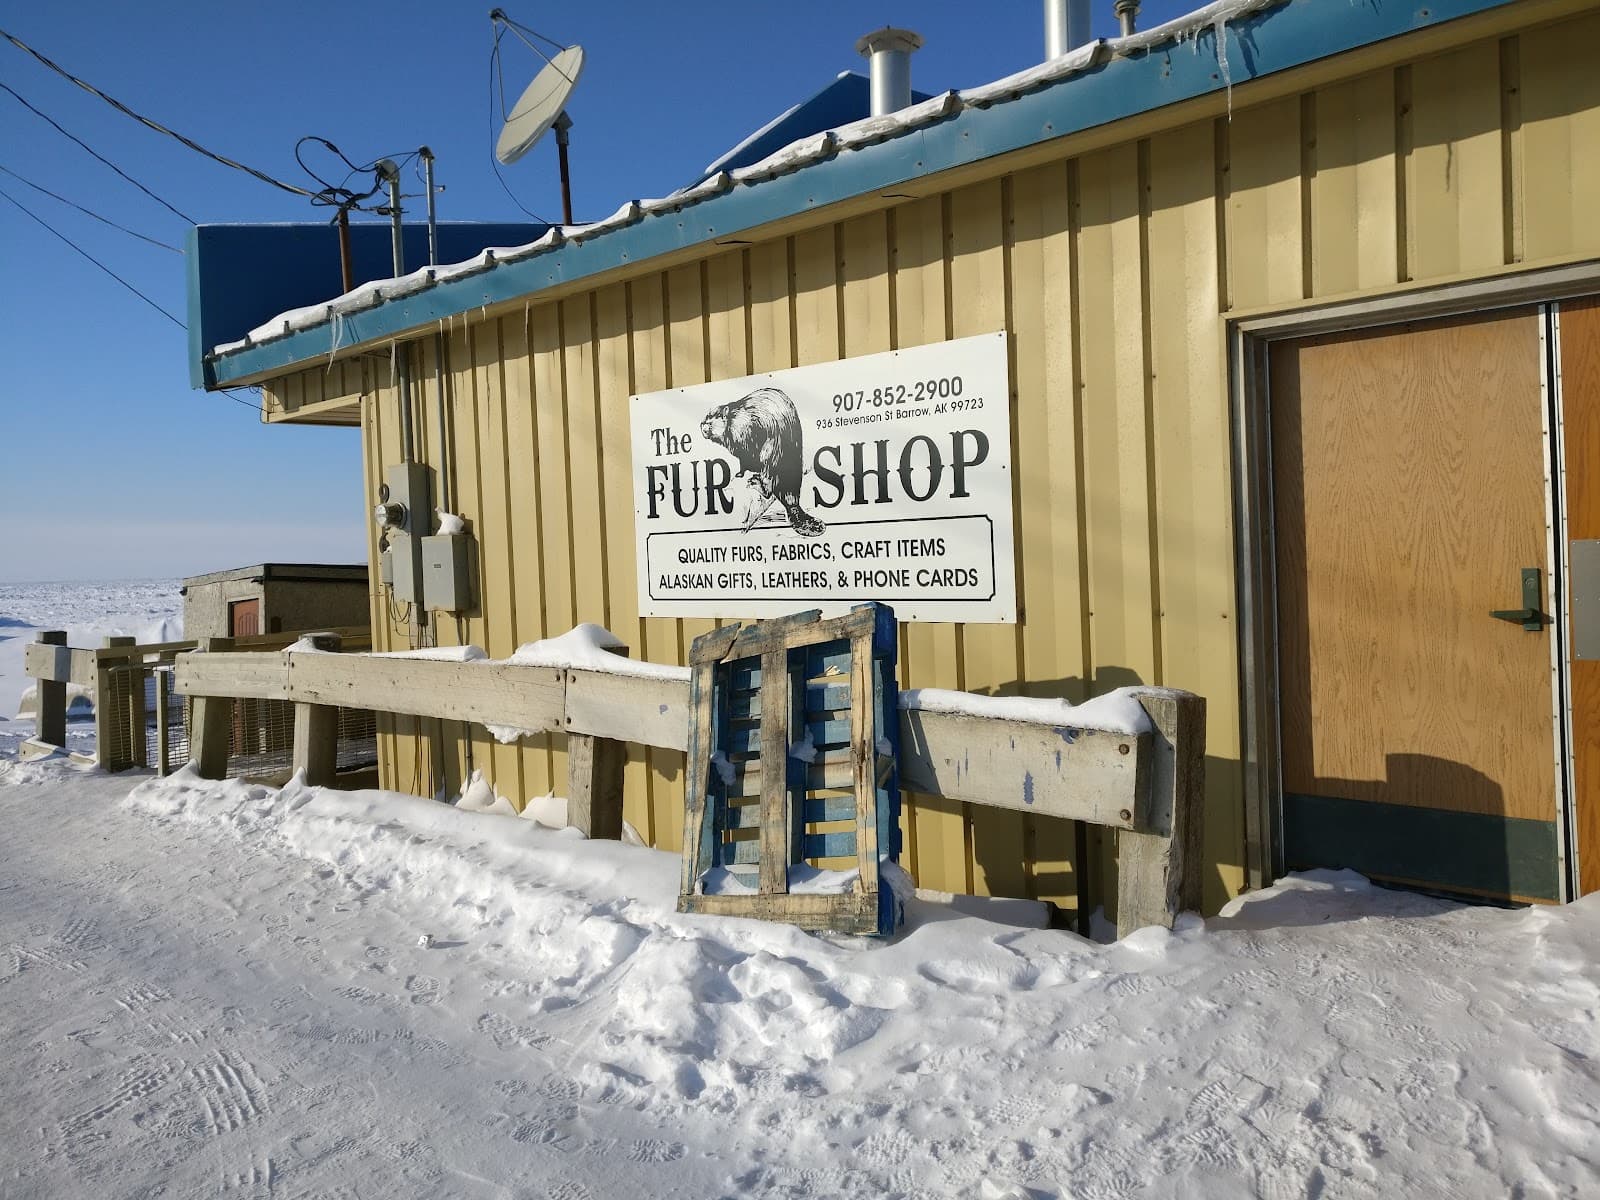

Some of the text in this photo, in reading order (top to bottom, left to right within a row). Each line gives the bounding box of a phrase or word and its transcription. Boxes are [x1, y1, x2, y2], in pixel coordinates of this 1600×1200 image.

[832, 375, 963, 411] 907-852-2900
[816, 398, 984, 430] 936 Stevenson St Barrow, AK 99723
[651, 428, 691, 456] The
[646, 429, 989, 519] FUR SHOP
[679, 538, 945, 563] QUALITY FURS, FABRICS, CRAFT ITEMS
[660, 568, 978, 590] ALASKAN GIFTS, LEATHERS, & PHONE CARDS
